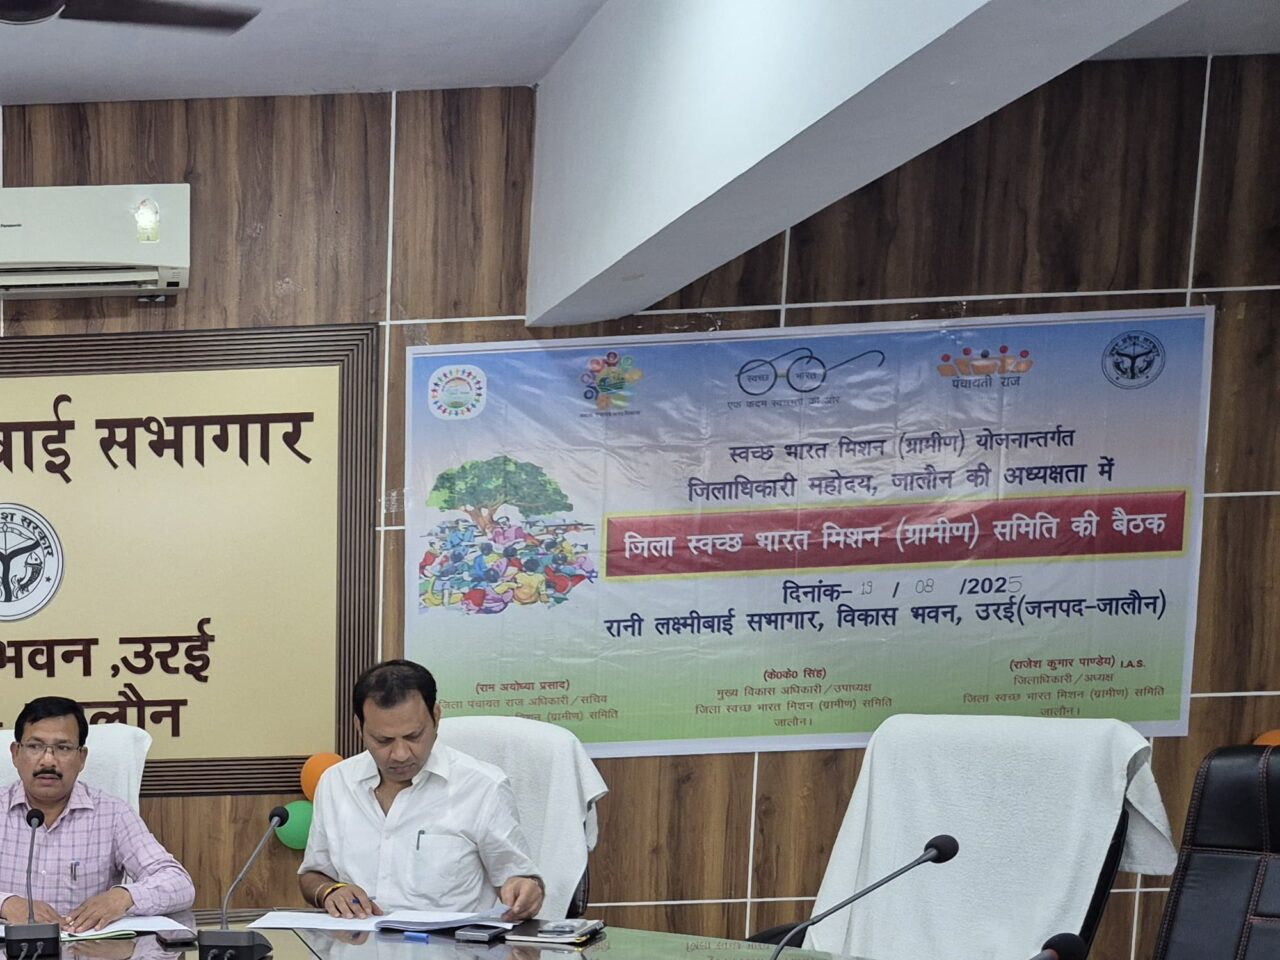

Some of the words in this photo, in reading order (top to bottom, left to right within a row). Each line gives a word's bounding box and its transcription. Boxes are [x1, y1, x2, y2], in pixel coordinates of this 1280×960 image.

[952, 373, 993, 389] पंचायती
[1000, 375, 1022, 388] राज
[95, 412, 314, 469] सभागार
[729, 445, 775, 463] स्वच्छ
[784, 442, 829, 460] भारत
[839, 436, 887, 457] मिशन
[898, 429, 965, 460] (ग्रामीण)
[976, 425, 1076, 450] योजनान्तर्गत
[688, 472, 798, 501] जिलाधिकारी
[808, 469, 878, 497] महोदय,
[891, 464, 955, 491] जालौन
[966, 462, 991, 488] की
[1004, 463, 1088, 486] अध्यक्षता
[1098, 456, 1115, 482] में
[21, 515, 54, 558] सरकार
[624, 531, 676, 559] जिला
[687, 534, 743, 555] स्वच्छ
[756, 530, 811, 552] भारत
[822, 521, 882, 550] मिशन
[896, 513, 980, 553] (ग्रामीण)
[992, 512, 1060, 542] समिति
[1071, 509, 1099, 538] की
[1112, 507, 1167, 535] बैठक
[604, 612, 644, 638] रानी
[655, 608, 735, 636] लक्ष्मीबाई
[746, 610, 825, 632] सभागार,
[837, 604, 898, 628] विकास
[911, 604, 962, 626] भवन,
[1009, 657, 1042, 672] (राजेश
[1047, 656, 1074, 671] कुमार
[1079, 654, 1116, 669] पाण्डेय)
[1120, 659, 1146, 668] I.A.S.
[803, 667, 827, 680] सिंह)
[476, 681, 495, 695] (राम
[539, 678, 571, 692] प्रसाद)
[744, 685, 775, 697] विकास
[963, 693, 989, 704] जिला
[1027, 691, 1051, 701] भारत
[1057, 688, 1084, 700] मिशन
[1134, 685, 1165, 697] समिति
[505, 699, 524, 708] राज
[696, 704, 720, 715] जिला
[726, 704, 752, 714] स्वच्छ
[757, 702, 781, 712] भारत
[787, 700, 814, 711] मिशन
[819, 698, 856, 711] (ग्रामीण)
[862, 696, 892, 708] समिति
[589, 708, 619, 720] समिति
